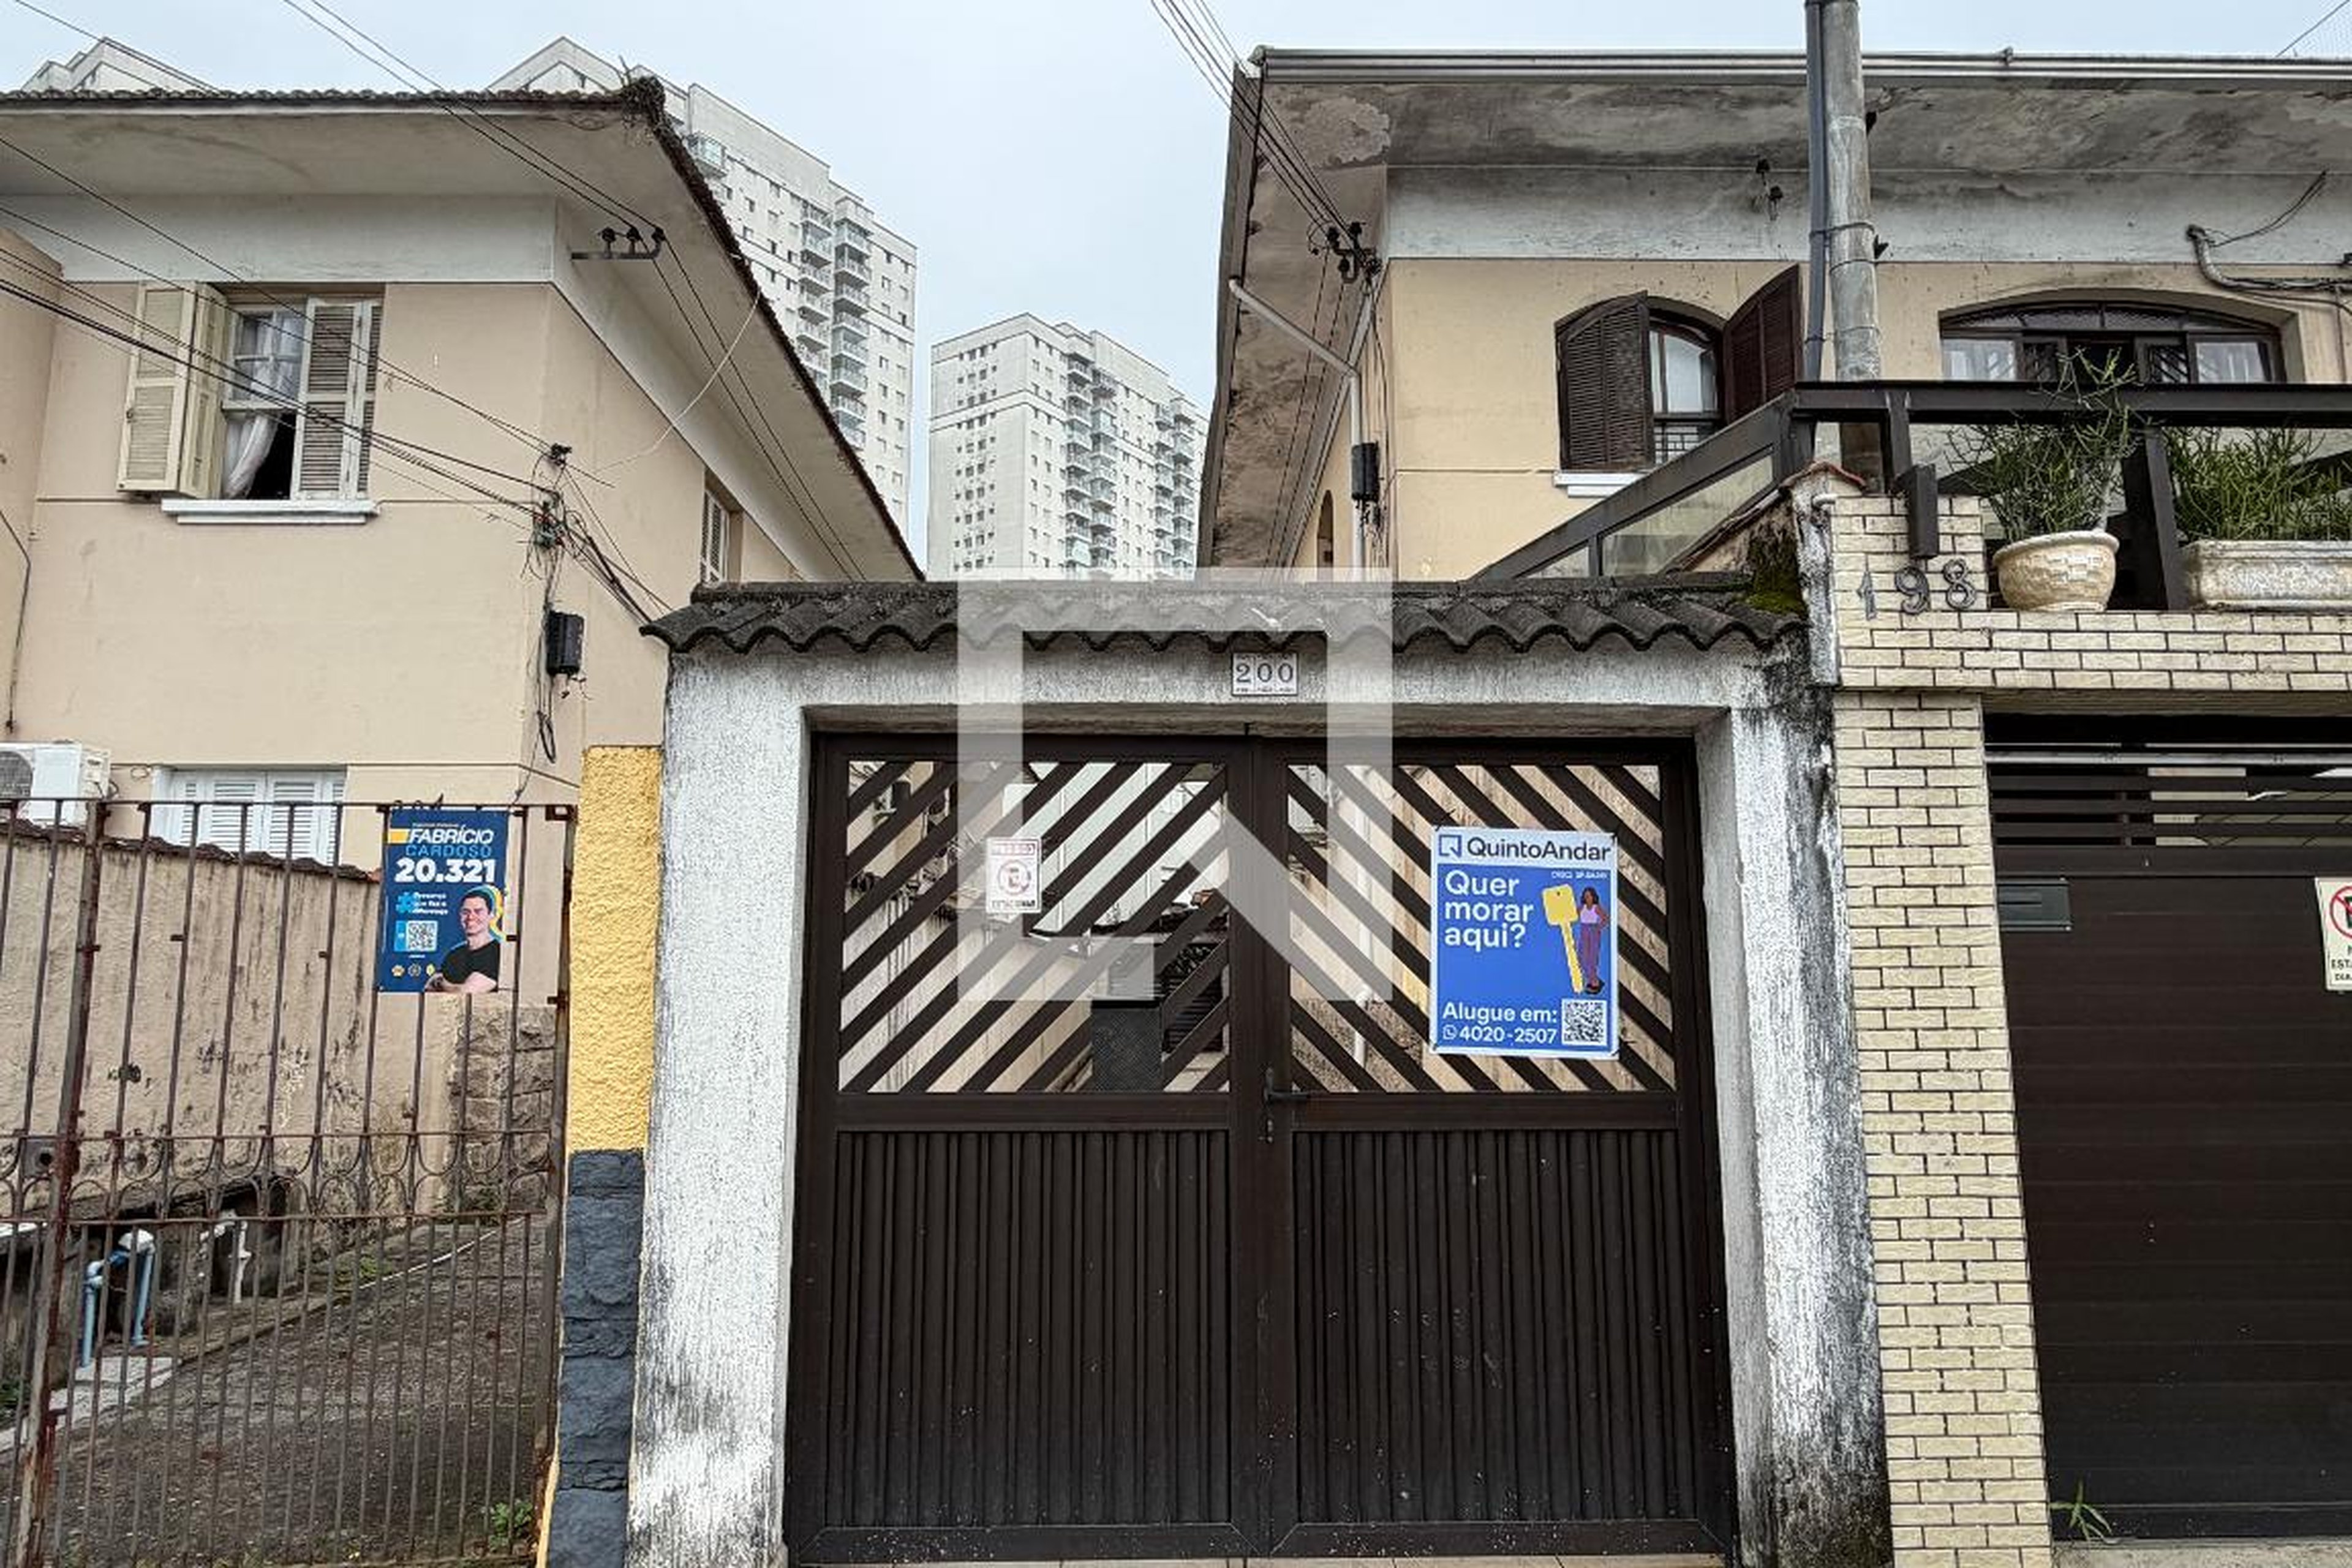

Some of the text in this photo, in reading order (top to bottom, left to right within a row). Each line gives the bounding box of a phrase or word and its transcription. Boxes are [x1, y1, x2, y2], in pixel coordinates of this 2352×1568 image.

[1856, 559, 1977, 621] 198
[1236, 663, 1294, 683] 200
[409, 824, 494, 843] FABRÍCIO
[405, 844, 492, 858] CARDOSO
[1467, 837, 1611, 861] QuintoAndar
[394, 858, 496, 883] 20.321
[1444, 870, 1520, 896] Quer
[1444, 900, 1534, 922] morar
[1444, 922, 1526, 952] aqui?
[1442, 1001, 1558, 1025] Alugue em:
[1459, 1026, 1558, 1044] 4020-2507
